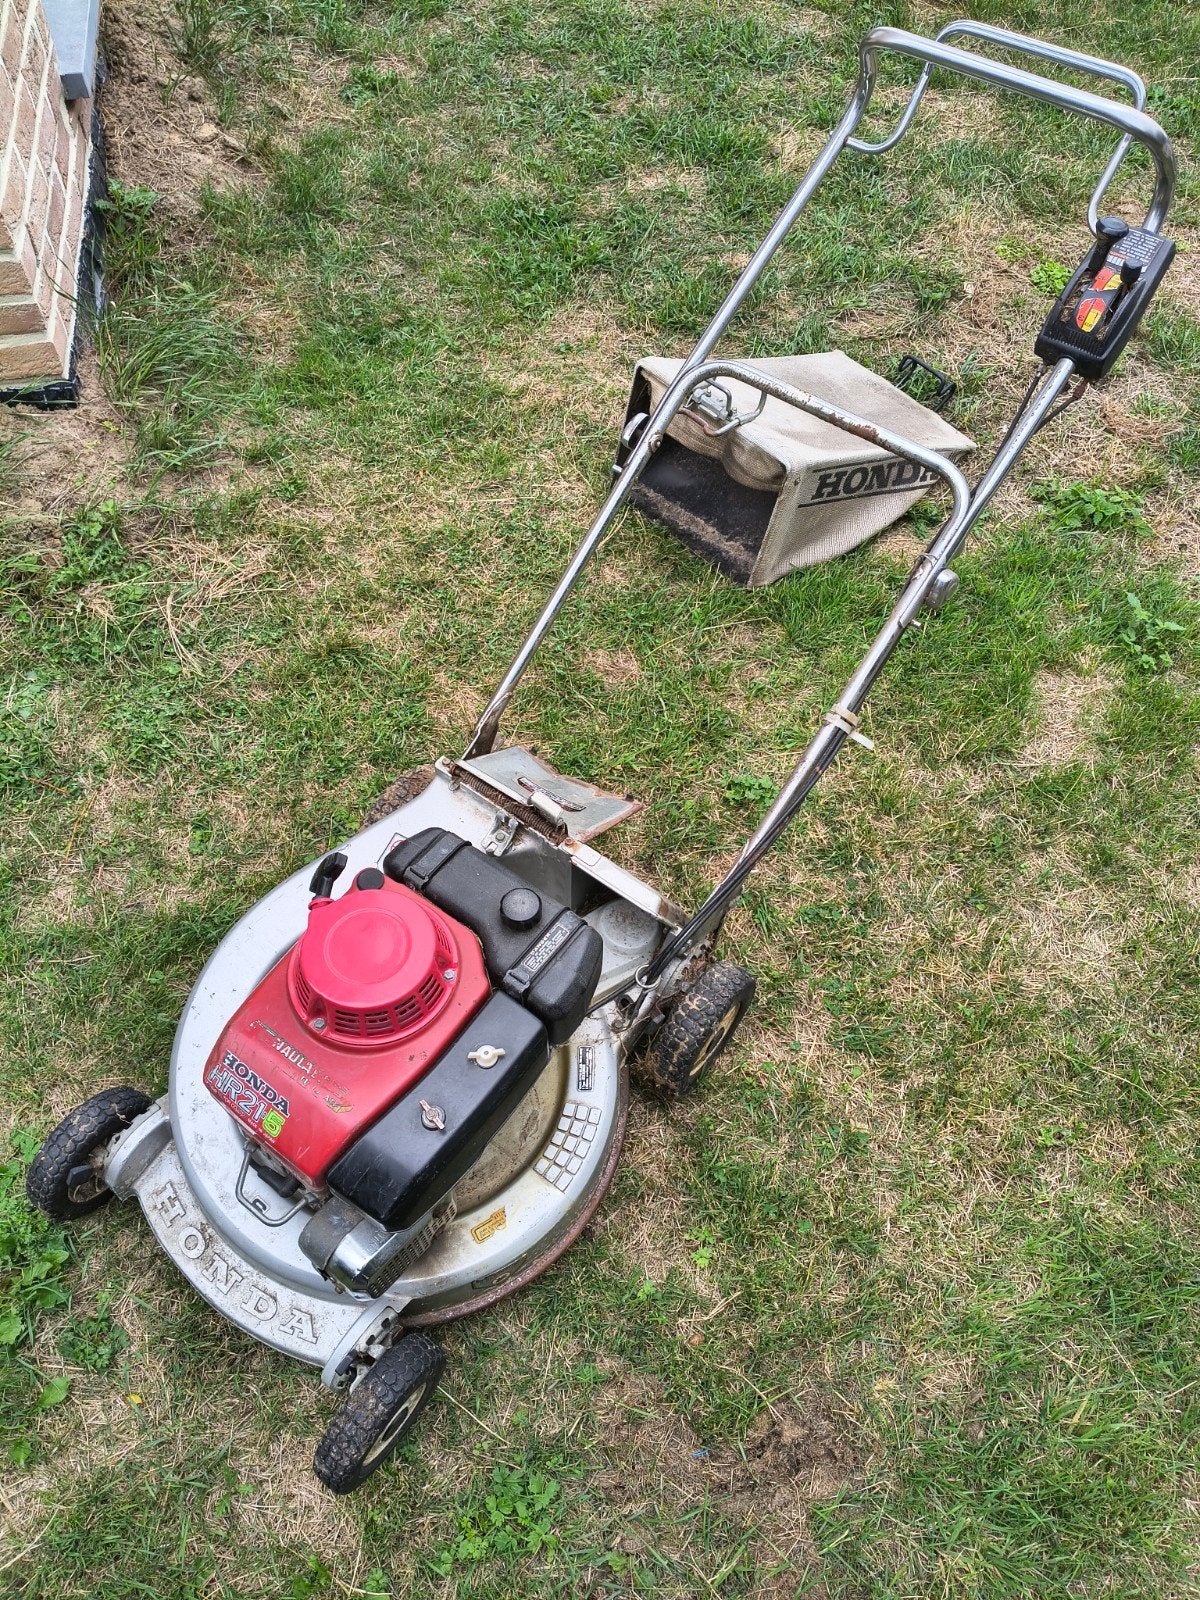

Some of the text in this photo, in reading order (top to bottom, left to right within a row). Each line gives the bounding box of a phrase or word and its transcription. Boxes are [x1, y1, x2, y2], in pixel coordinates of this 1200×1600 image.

[208, 1064, 286, 1138] HR21-5
[222, 1050, 291, 1118] HONDA
[152, 1181, 318, 1344] HONDA
